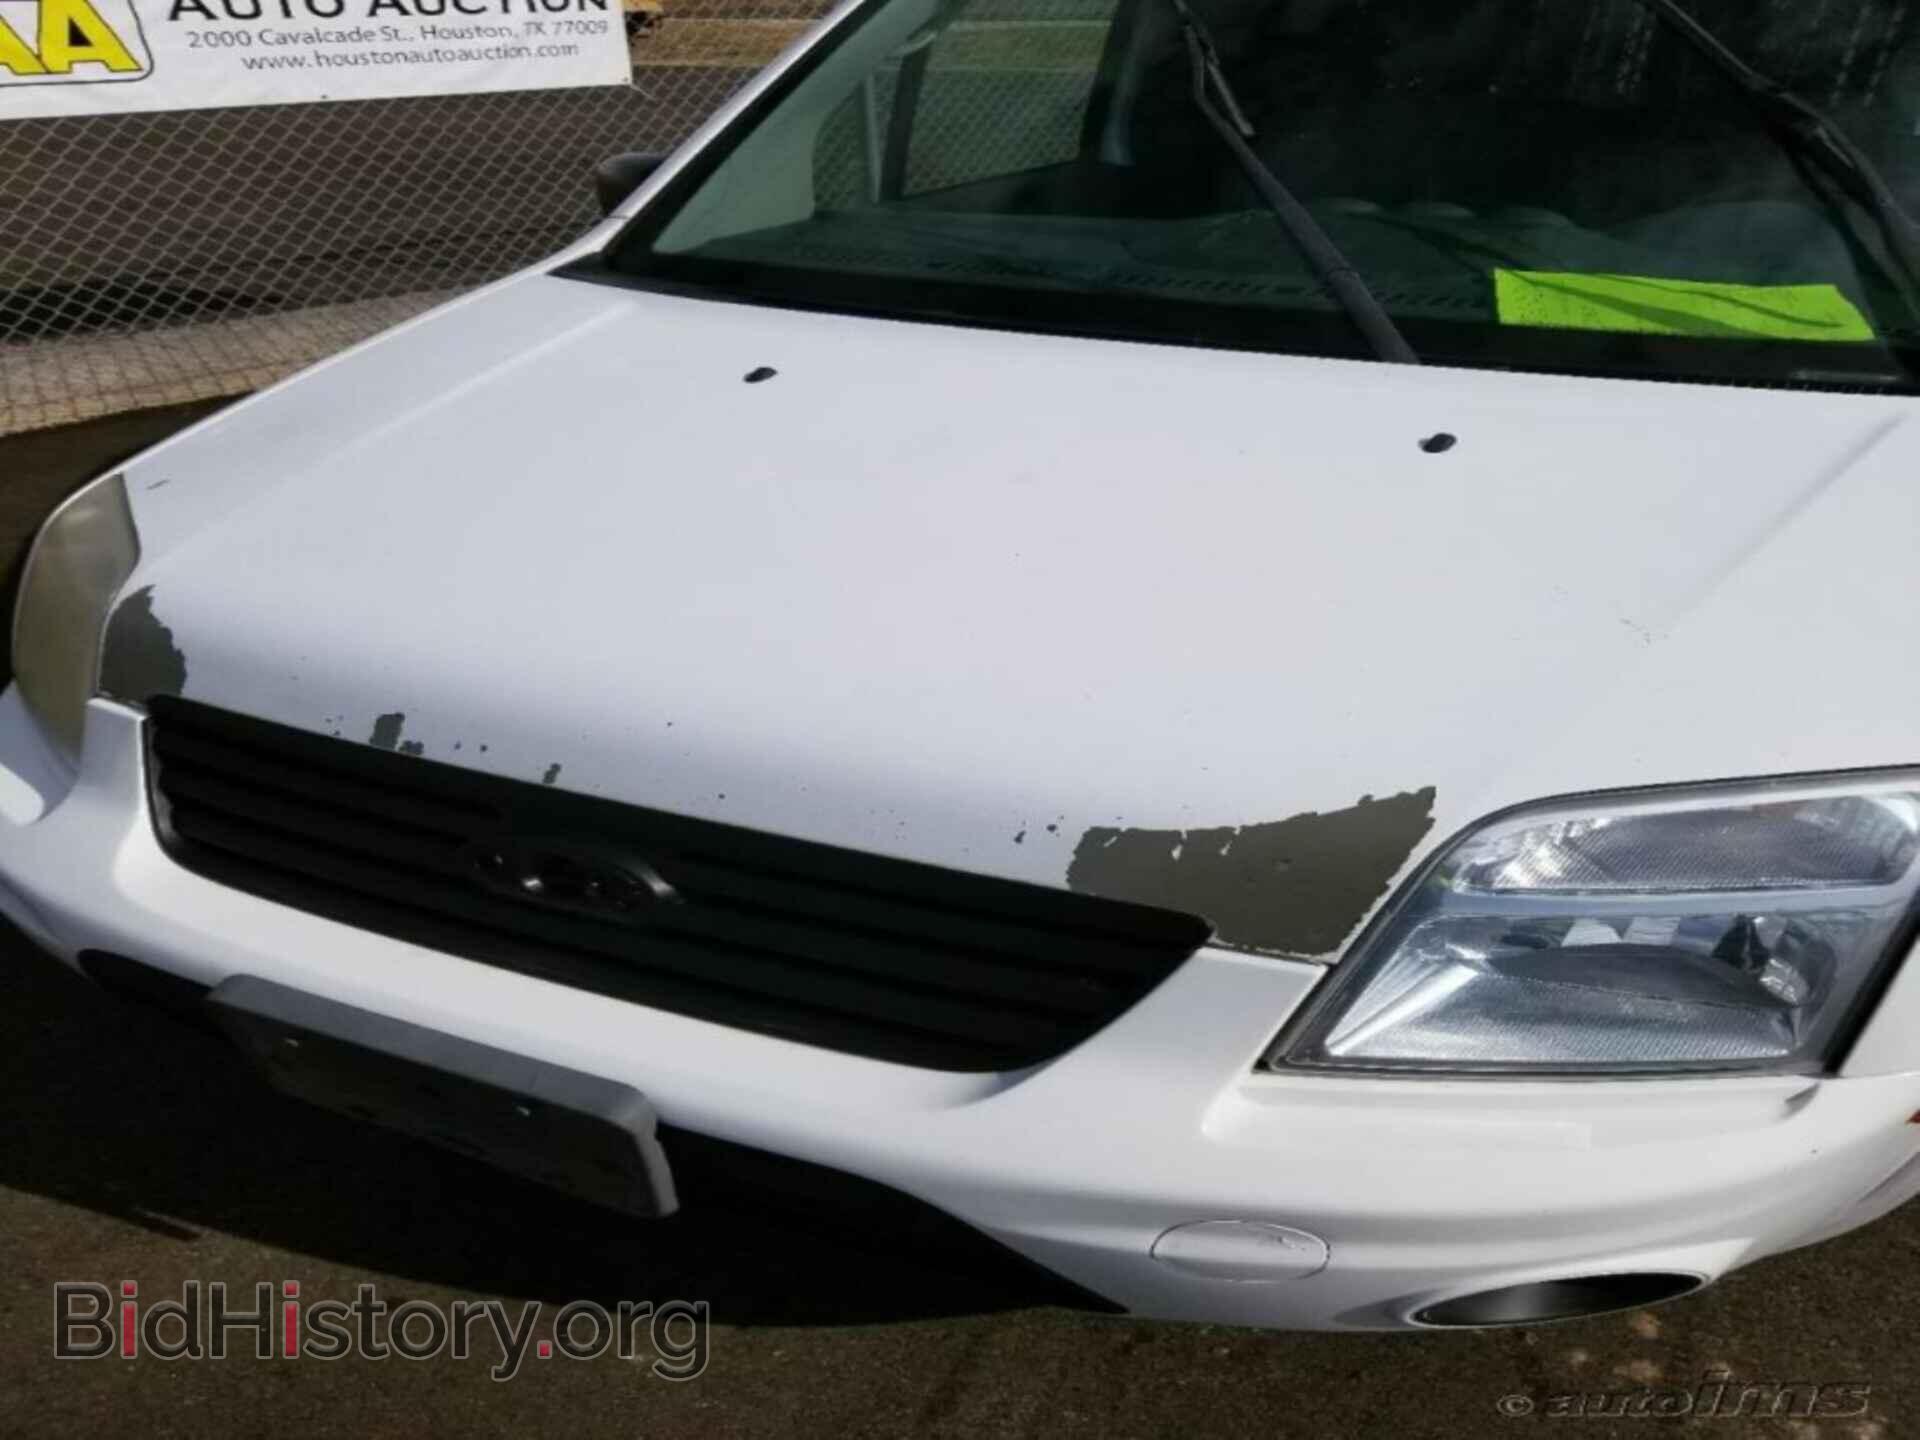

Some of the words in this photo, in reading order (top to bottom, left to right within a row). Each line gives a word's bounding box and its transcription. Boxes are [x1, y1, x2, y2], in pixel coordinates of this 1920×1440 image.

[185, 30, 251, 48] 2000
[258, 27, 376, 46] Cavalcade
[551, 20, 609, 35] 77009
[241, 43, 580, 70] www.houstonautoauction.com
